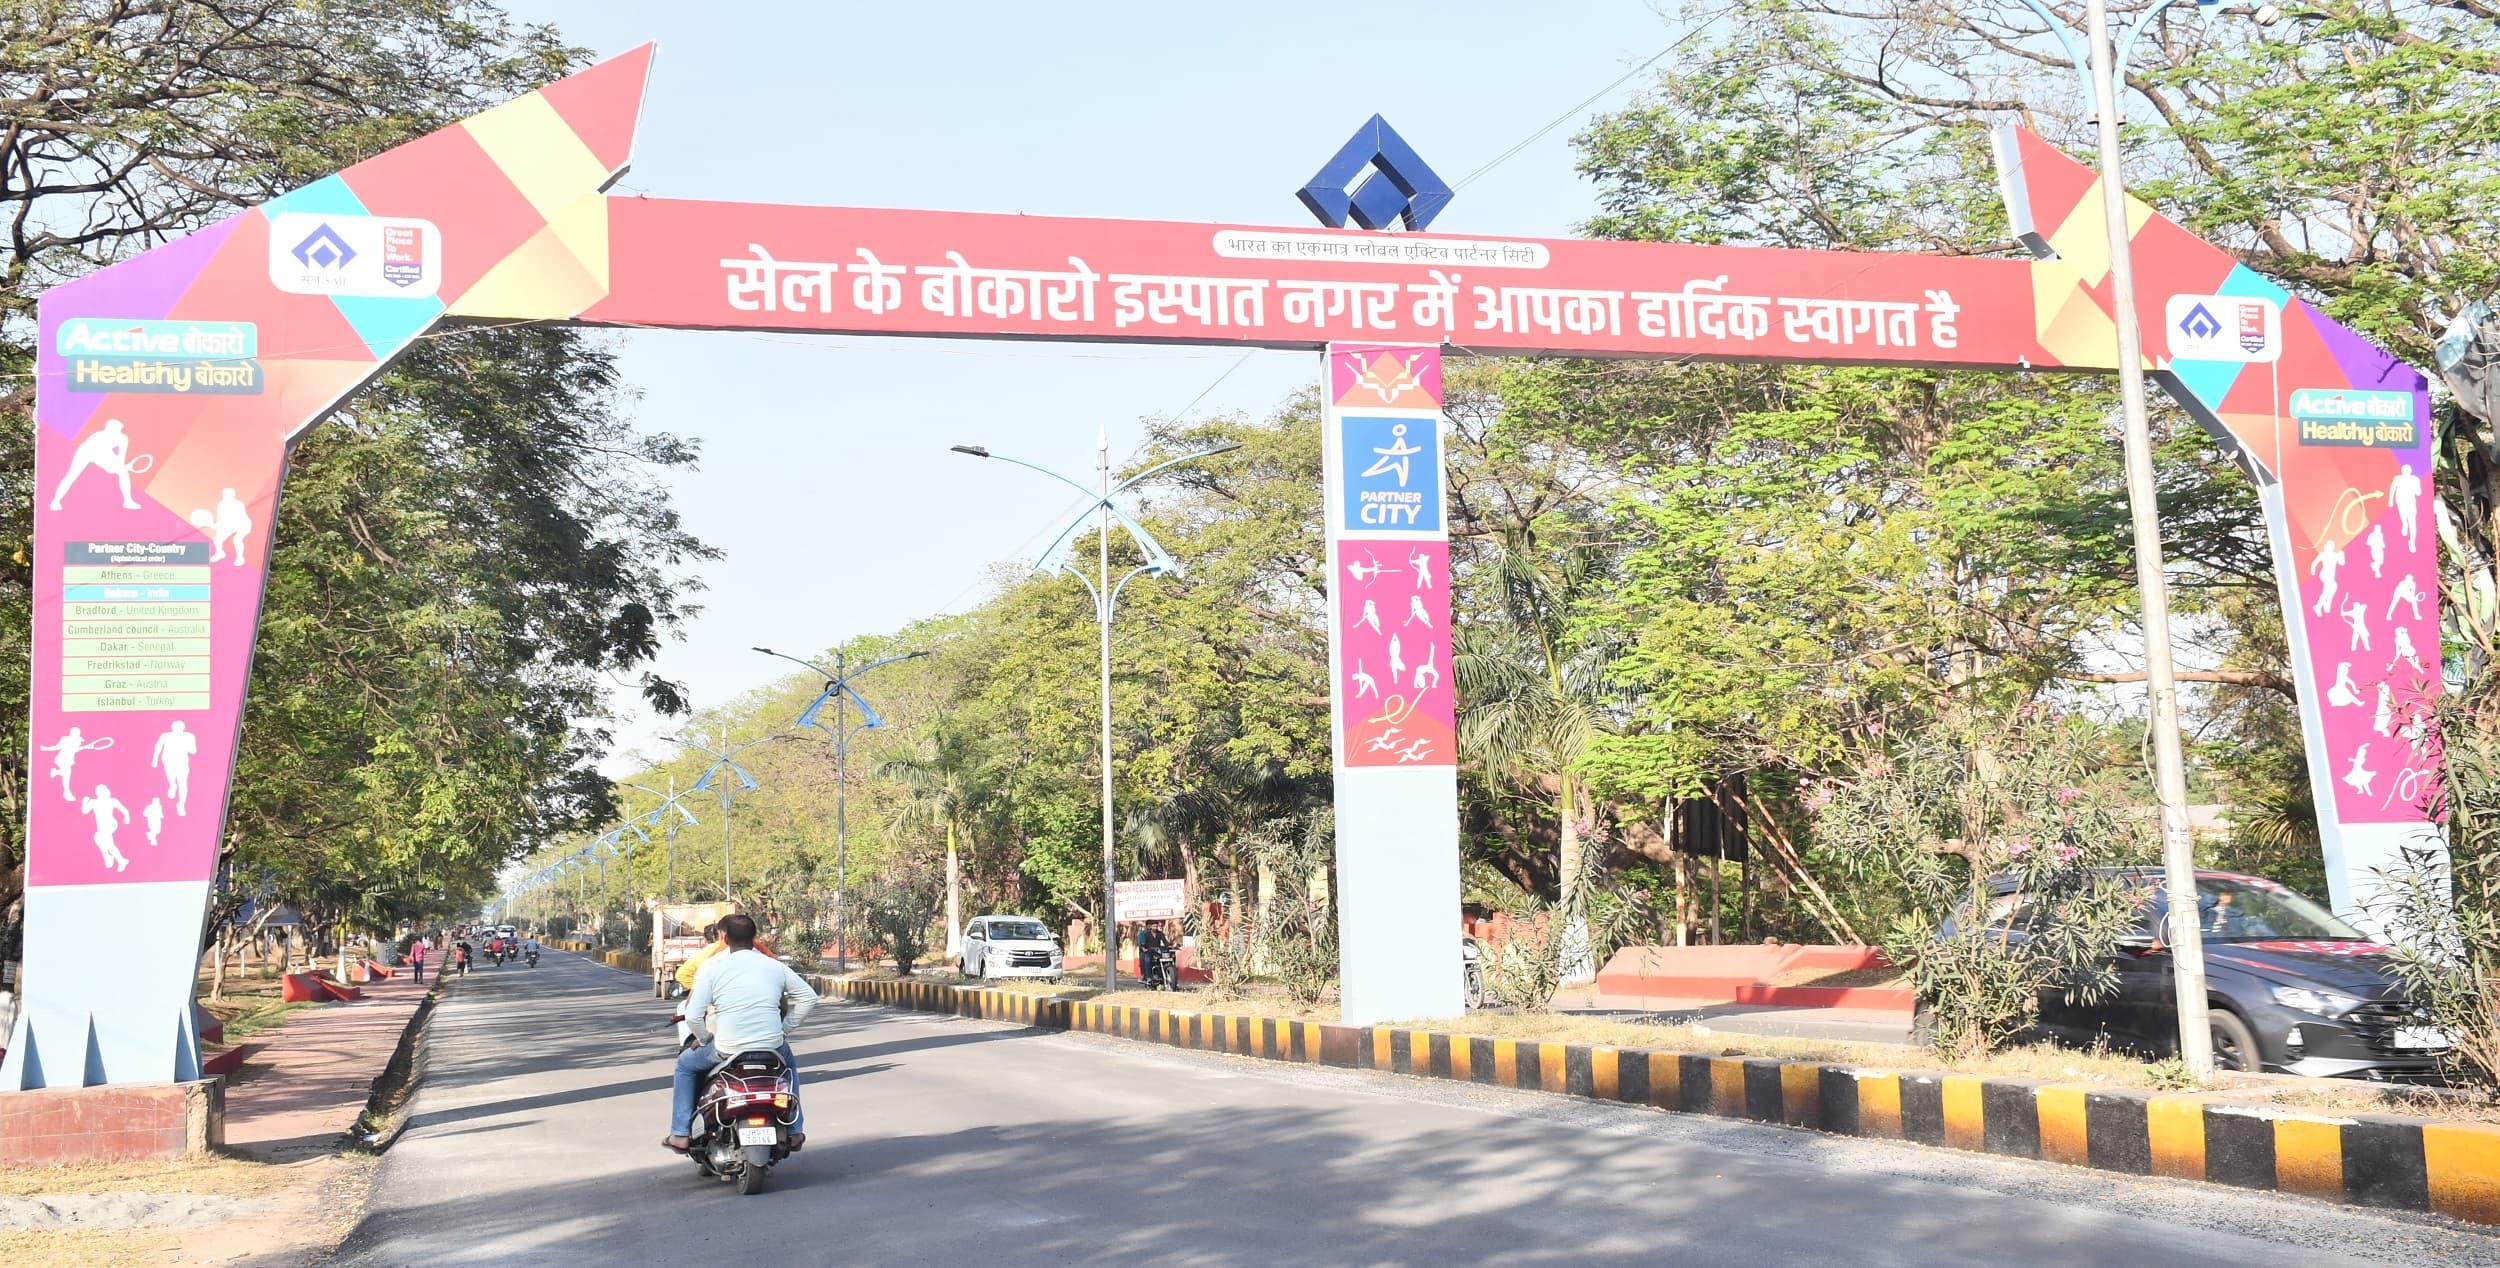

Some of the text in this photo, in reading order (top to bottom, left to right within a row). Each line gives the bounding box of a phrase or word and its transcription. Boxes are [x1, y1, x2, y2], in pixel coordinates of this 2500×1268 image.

[1228, 238, 1266, 252] भारत
[1271, 240, 1291, 253] का
[1296, 242, 1348, 257] एकमात्र
[1454, 243, 1498, 261] पार्टनर
[1502, 246, 1535, 262] सिटी
[720, 243, 1960, 348] सेल के बोकारो इस्पात नगर में आपका हार्दिक स्वागत है
[64, 322, 245, 355] Active बोकारो
[76, 359, 255, 393] Healthy बोकारो
[2294, 392, 2366, 416] Active
[2302, 421, 2413, 447] Healthy बोकारो
[1360, 490, 1422, 503] PARTNER
[1360, 503, 1422, 525] CITY
[88, 542, 186, 556] Partner City-Country
[101, 570, 133, 580] Athens
[143, 570, 175, 580] Greece
[75, 605, 117, 615] Bradford
[126, 605, 155, 615] United
[158, 605, 199, 616] Kingdom
[67, 625, 123, 635] Cumberland
[126, 624, 158, 634] council
[100, 642, 127, 652] Dakar
[137, 641, 174, 652] Senegal
[87, 660, 141, 670] Fredrikstad
[105, 679, 127, 689] Graz
[97, 697, 135, 706] Istanbul
[145, 696, 175, 707] Turkey
